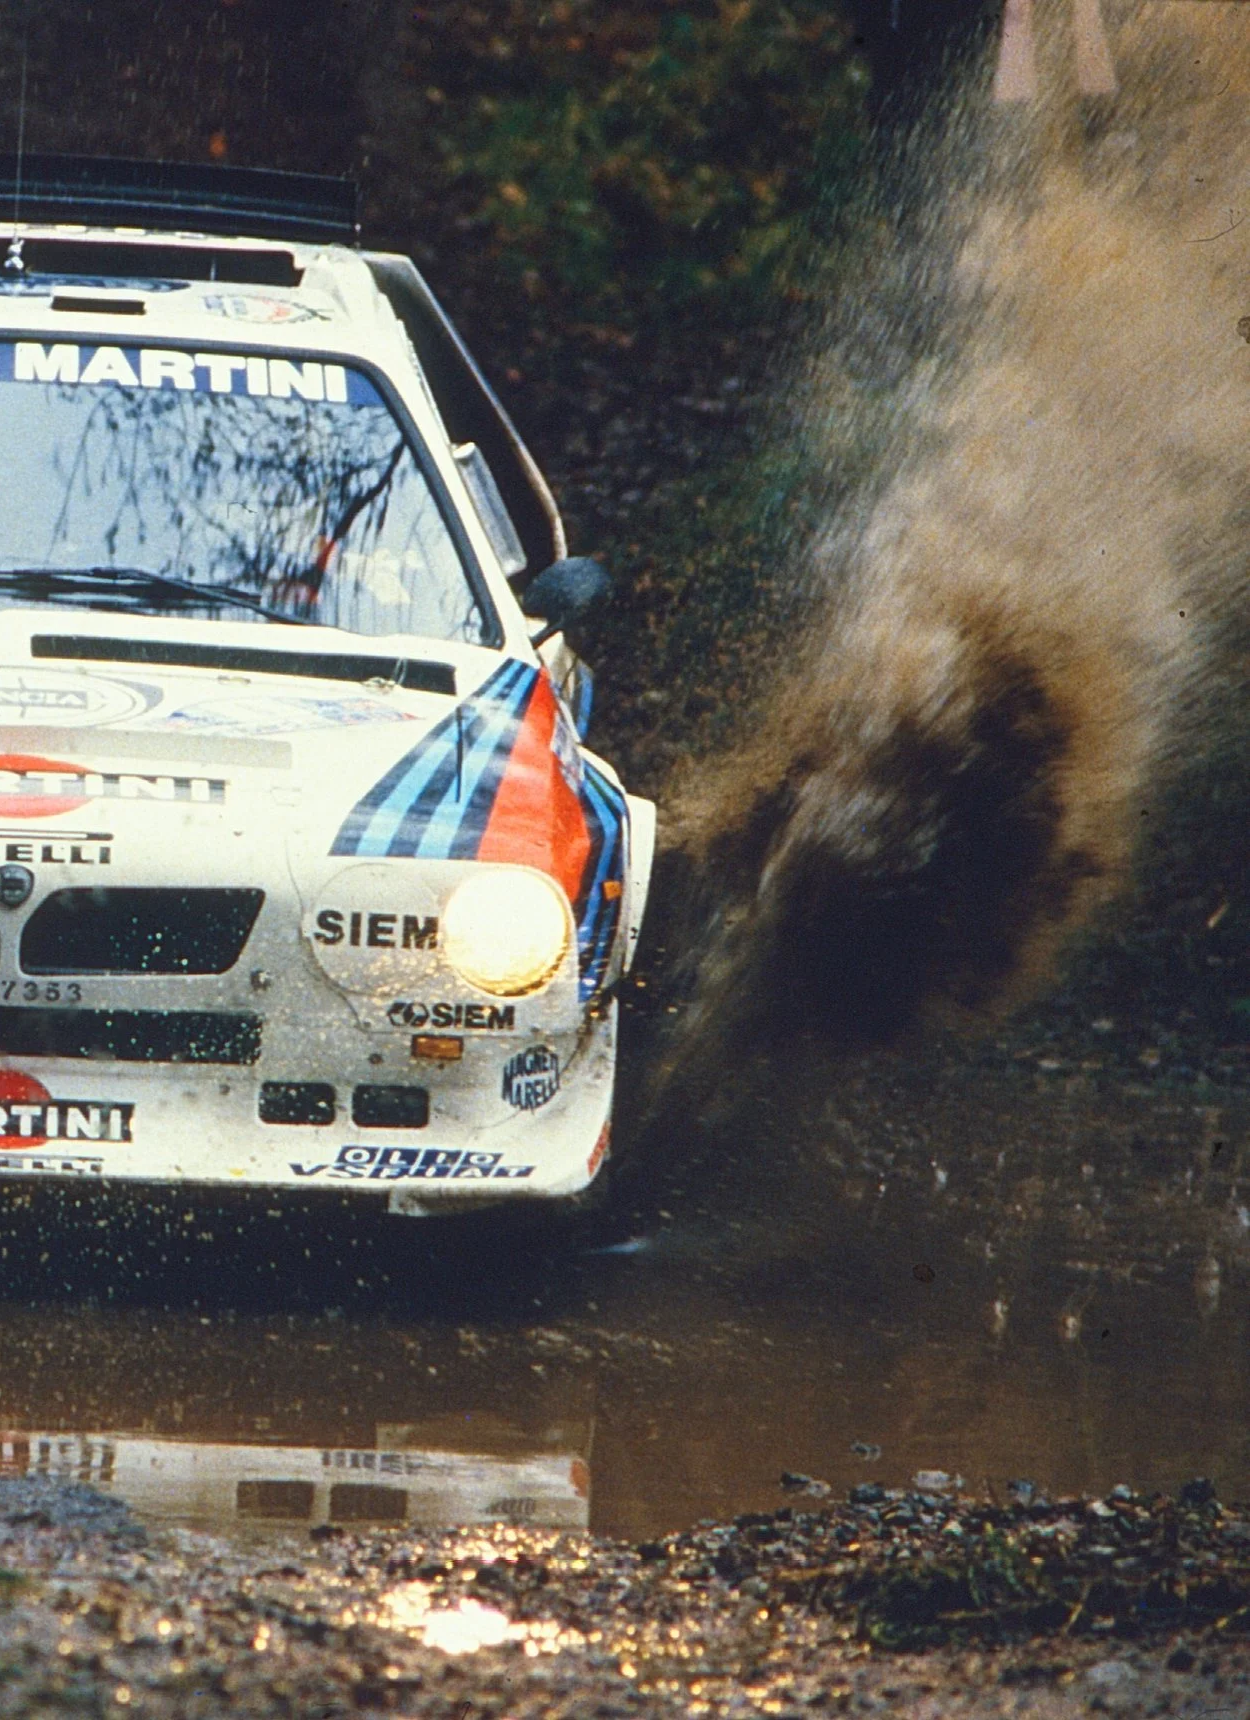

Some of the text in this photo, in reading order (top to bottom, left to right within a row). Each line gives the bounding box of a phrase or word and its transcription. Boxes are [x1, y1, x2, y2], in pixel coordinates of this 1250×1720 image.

[14, 341, 348, 403] MARTINI
[313, 908, 440, 950] SIEM
[430, 1002, 515, 1030] SIEM
[339, 1146, 500, 1166] OLIO
